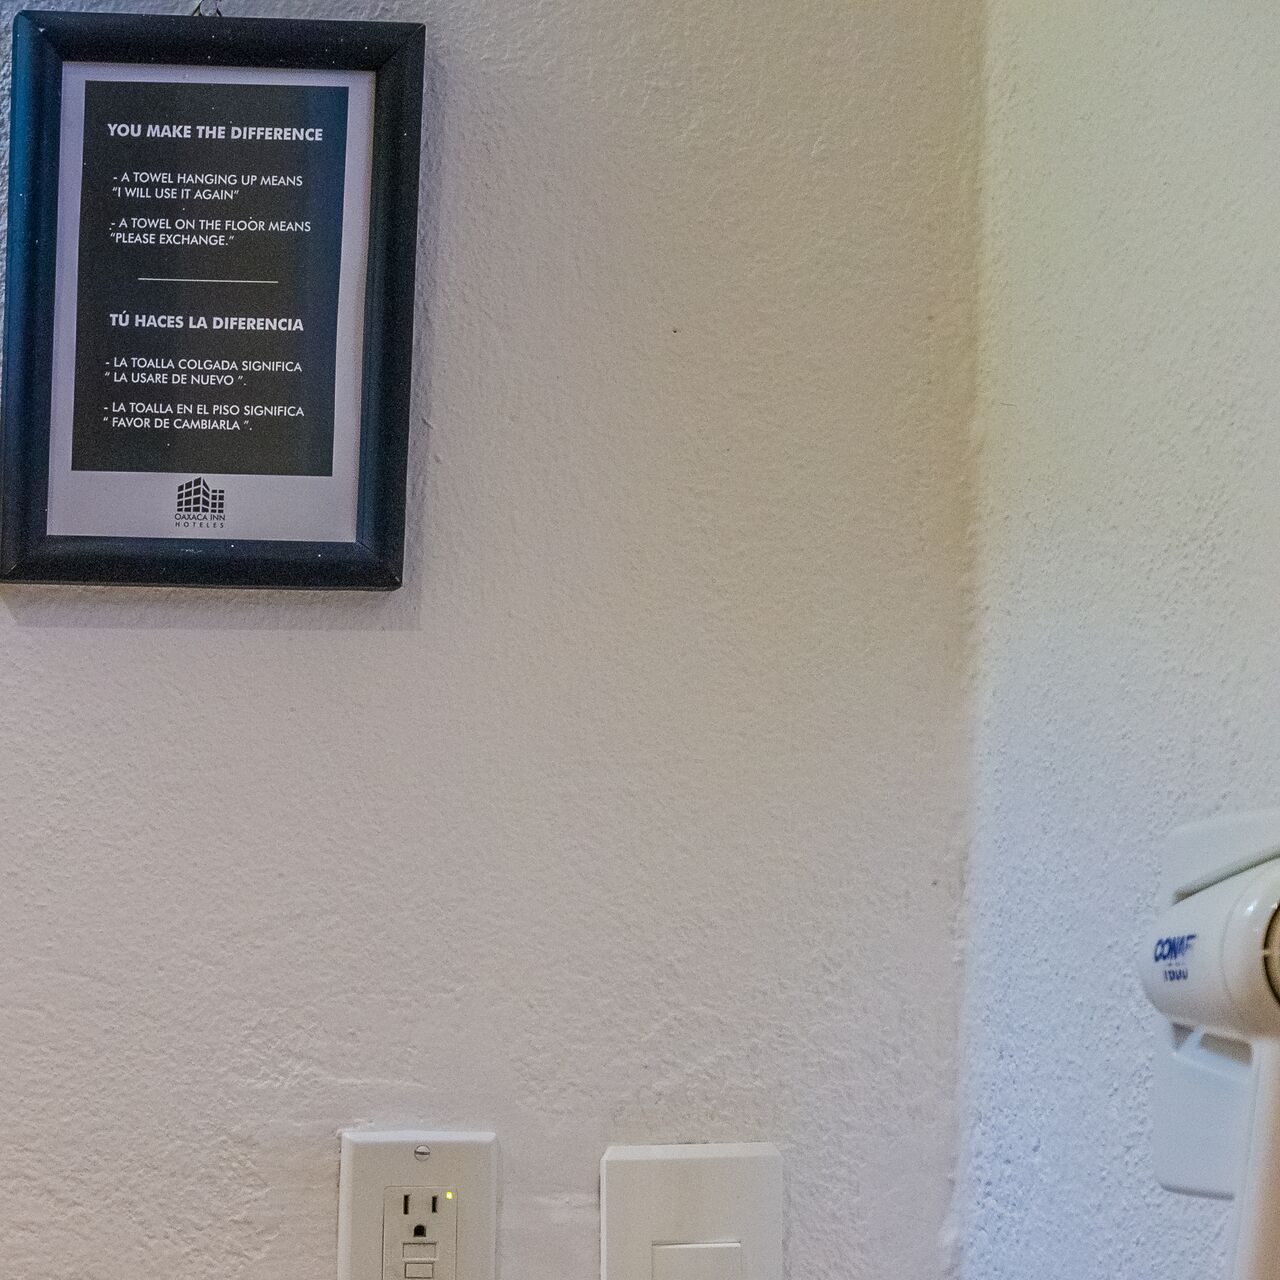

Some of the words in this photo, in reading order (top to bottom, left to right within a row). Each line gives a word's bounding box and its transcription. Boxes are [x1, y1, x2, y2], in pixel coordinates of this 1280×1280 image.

[107, 123, 142, 138] YOU
[146, 125, 192, 139] MAKE
[196, 125, 226, 140] THE
[230, 126, 324, 142] DIFFERENCE
[121, 172, 130, 183] A
[133, 172, 174, 184] TOWEL
[177, 173, 238, 186] HANGING
[241, 175, 258, 186] UP
[260, 175, 303, 187] MEANS
[125, 187, 152, 199] WILL
[155, 188, 178, 200] USE
[181, 188, 191, 200] IT
[118, 218, 128, 228] A
[131, 218, 172, 230] TOWEL
[175, 219, 196, 230] ON
[199, 219, 221, 231] THE
[225, 220, 266, 232] FLOOR
[268, 221, 312, 232] MEANS
[110, 310, 130, 328] TÚ
[135, 314, 184, 329] HACES
[189, 316, 208, 330] LA
[212, 317, 304, 332] DIFERENCIA
[113, 357, 128, 368] LA
[131, 357, 175, 370] TOALLA
[178, 358, 238, 371] COLGADA
[241, 360, 302, 372] SIGNIFICA
[113, 372, 128, 383] LA
[131, 373, 168, 384] USARE
[171, 374, 188, 385] DE
[190, 374, 234, 386] NUEVO
[112, 402, 126, 413] LA
[129, 402, 174, 414] TOALLA
[177, 403, 194, 414] EN
[197, 404, 210, 416] EL
[212, 404, 240, 416] PISO
[243, 405, 305, 418] SIGNIFICA
[112, 417, 151, 429] FAVOR
[154, 418, 170, 428] DE
[173, 418, 241, 431] CAMBIARLA
[175, 513, 208, 521] OAXACA
